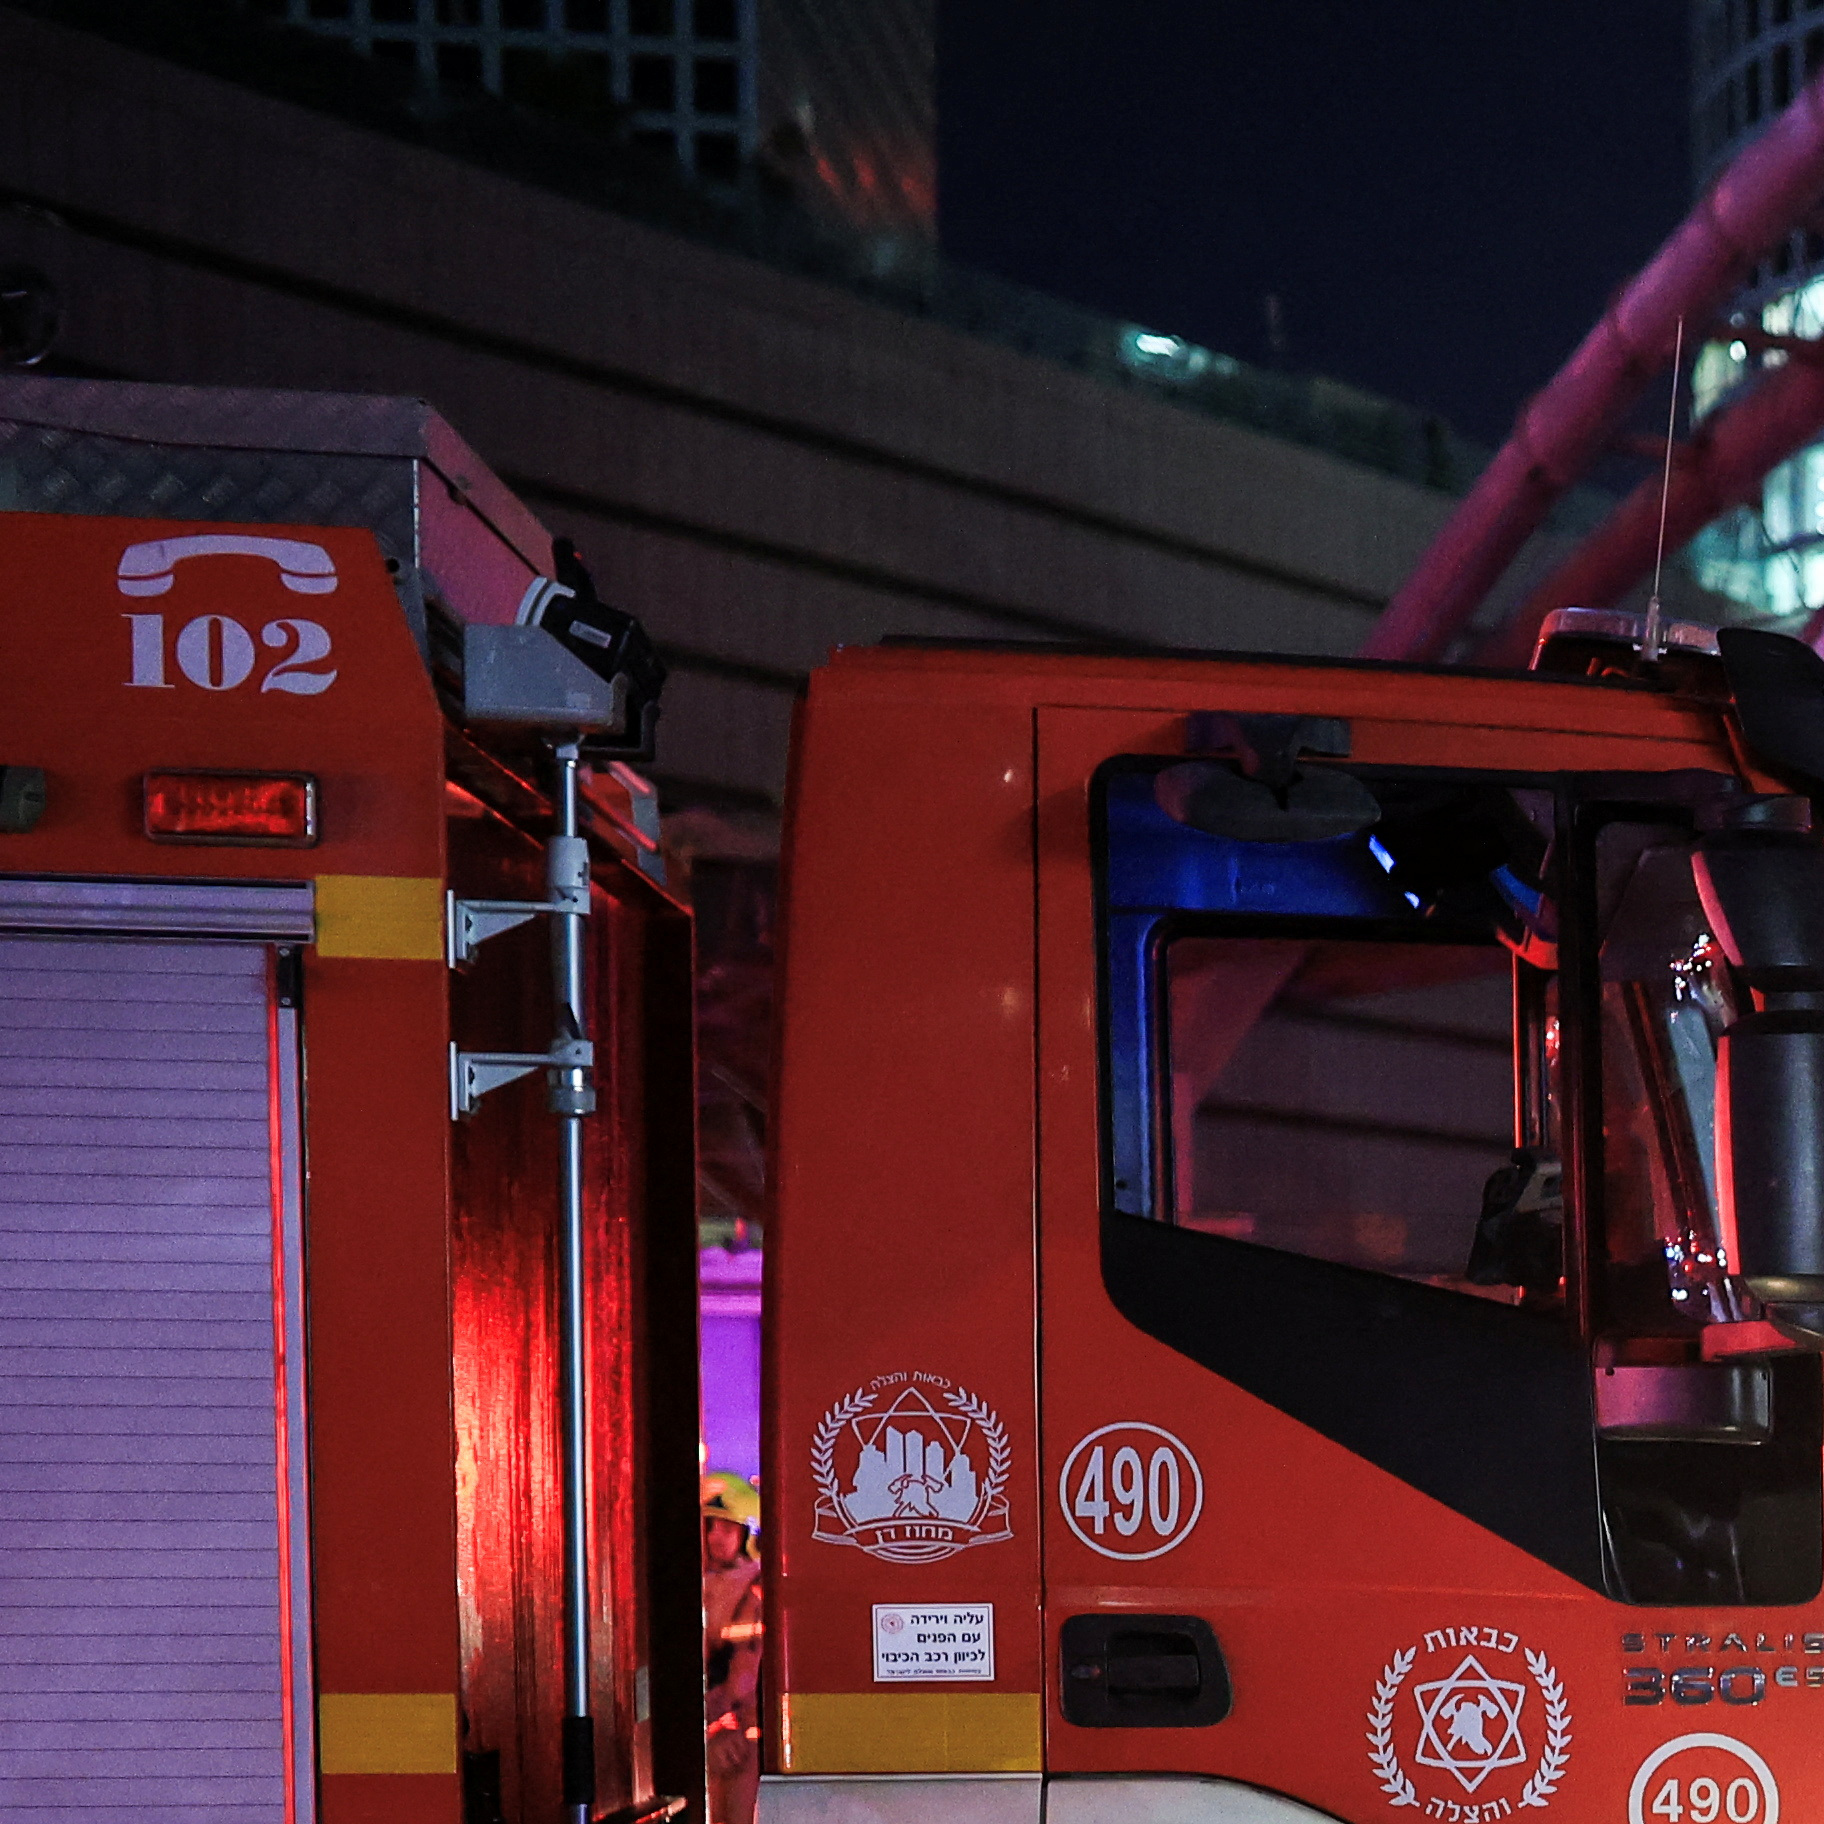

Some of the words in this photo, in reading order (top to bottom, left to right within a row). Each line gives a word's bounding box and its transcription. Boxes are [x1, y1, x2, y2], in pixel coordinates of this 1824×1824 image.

[120, 612, 338, 696] 102
[1074, 1445, 1180, 1537] 490
[904, 1524, 954, 1541] מחוז
[910, 1613, 948, 1625] וירידה
[953, 1611, 984, 1626] עליה
[916, 1632, 957, 1644] הפנים
[961, 1632, 981, 1644] עם
[1423, 1626, 1519, 1653] כבאות
[881, 1651, 919, 1663] הכיבוי
[924, 1651, 949, 1662] רכב
[953, 1648, 986, 1665] לכיוון
[1623, 1666, 1766, 1706] 360
[1652, 1776, 1759, 1824] 490
[1425, 1796, 1512, 1824] והצלה
